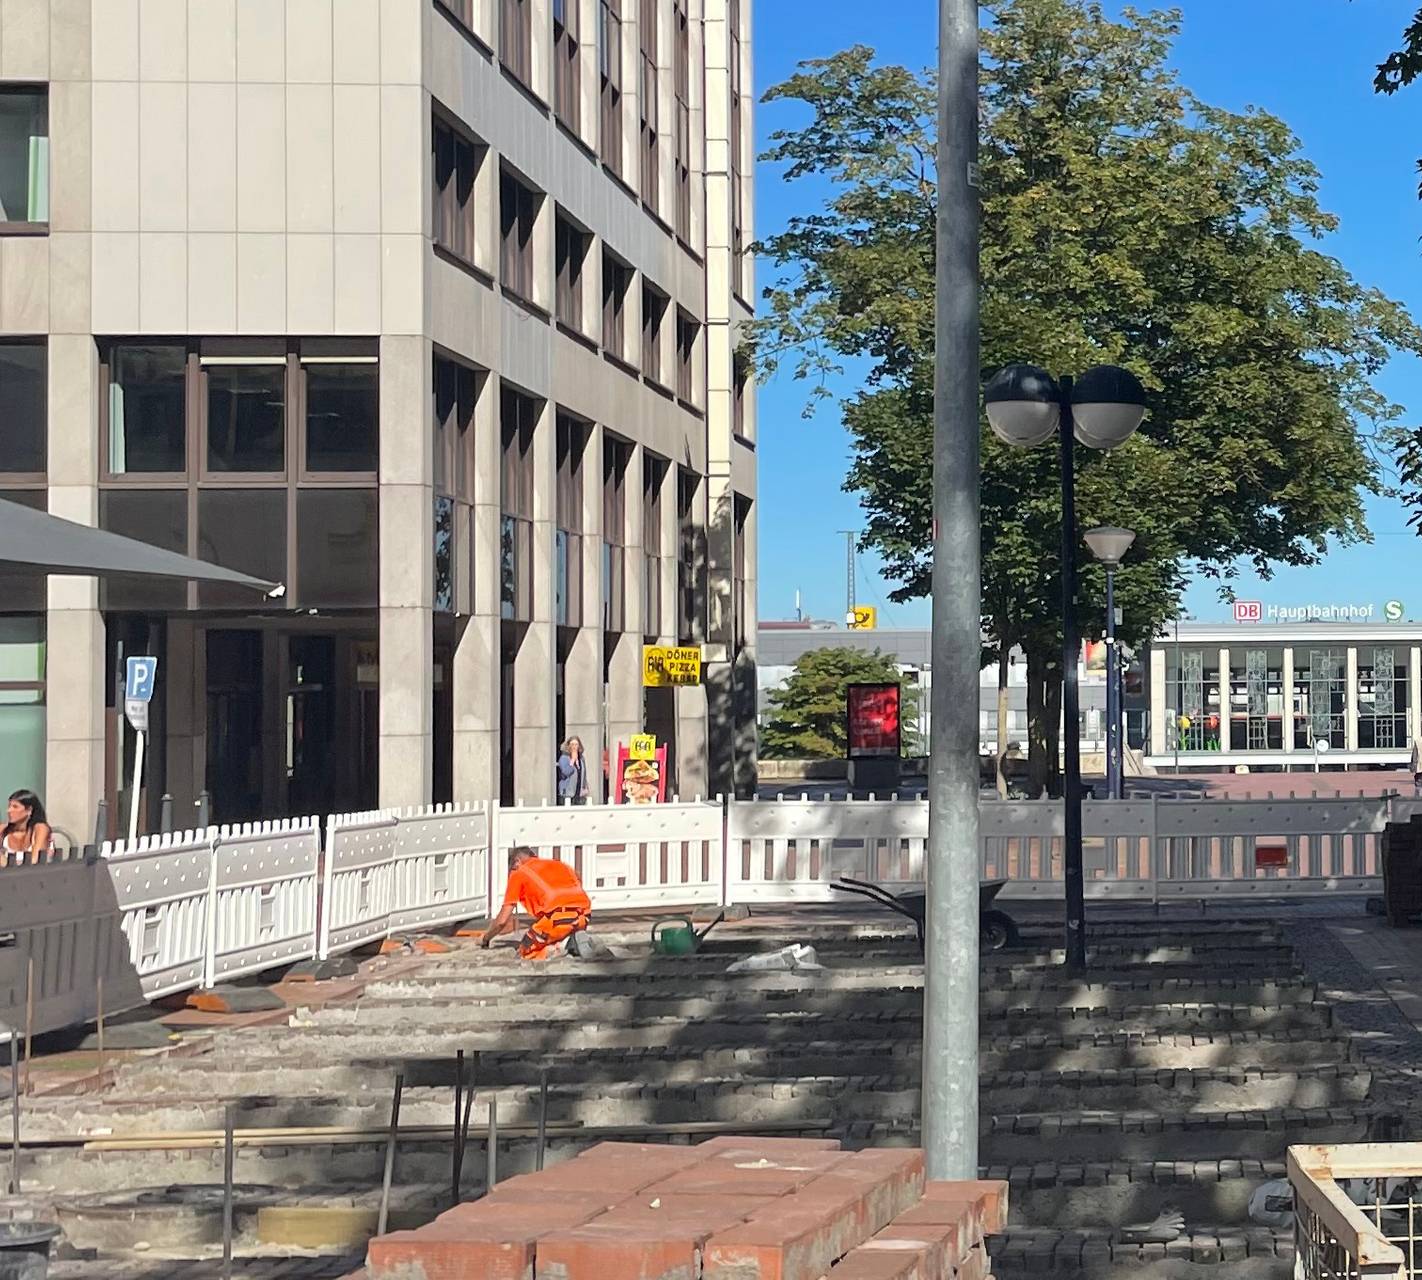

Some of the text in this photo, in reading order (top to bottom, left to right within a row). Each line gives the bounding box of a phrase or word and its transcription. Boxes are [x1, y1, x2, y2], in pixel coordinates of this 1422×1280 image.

[1237, 600, 1402, 620] DB Hauptbahnhof S
[666, 649, 699, 661] DÖNER
[669, 662, 696, 672] PIZZA
[132, 663, 148, 696] P
